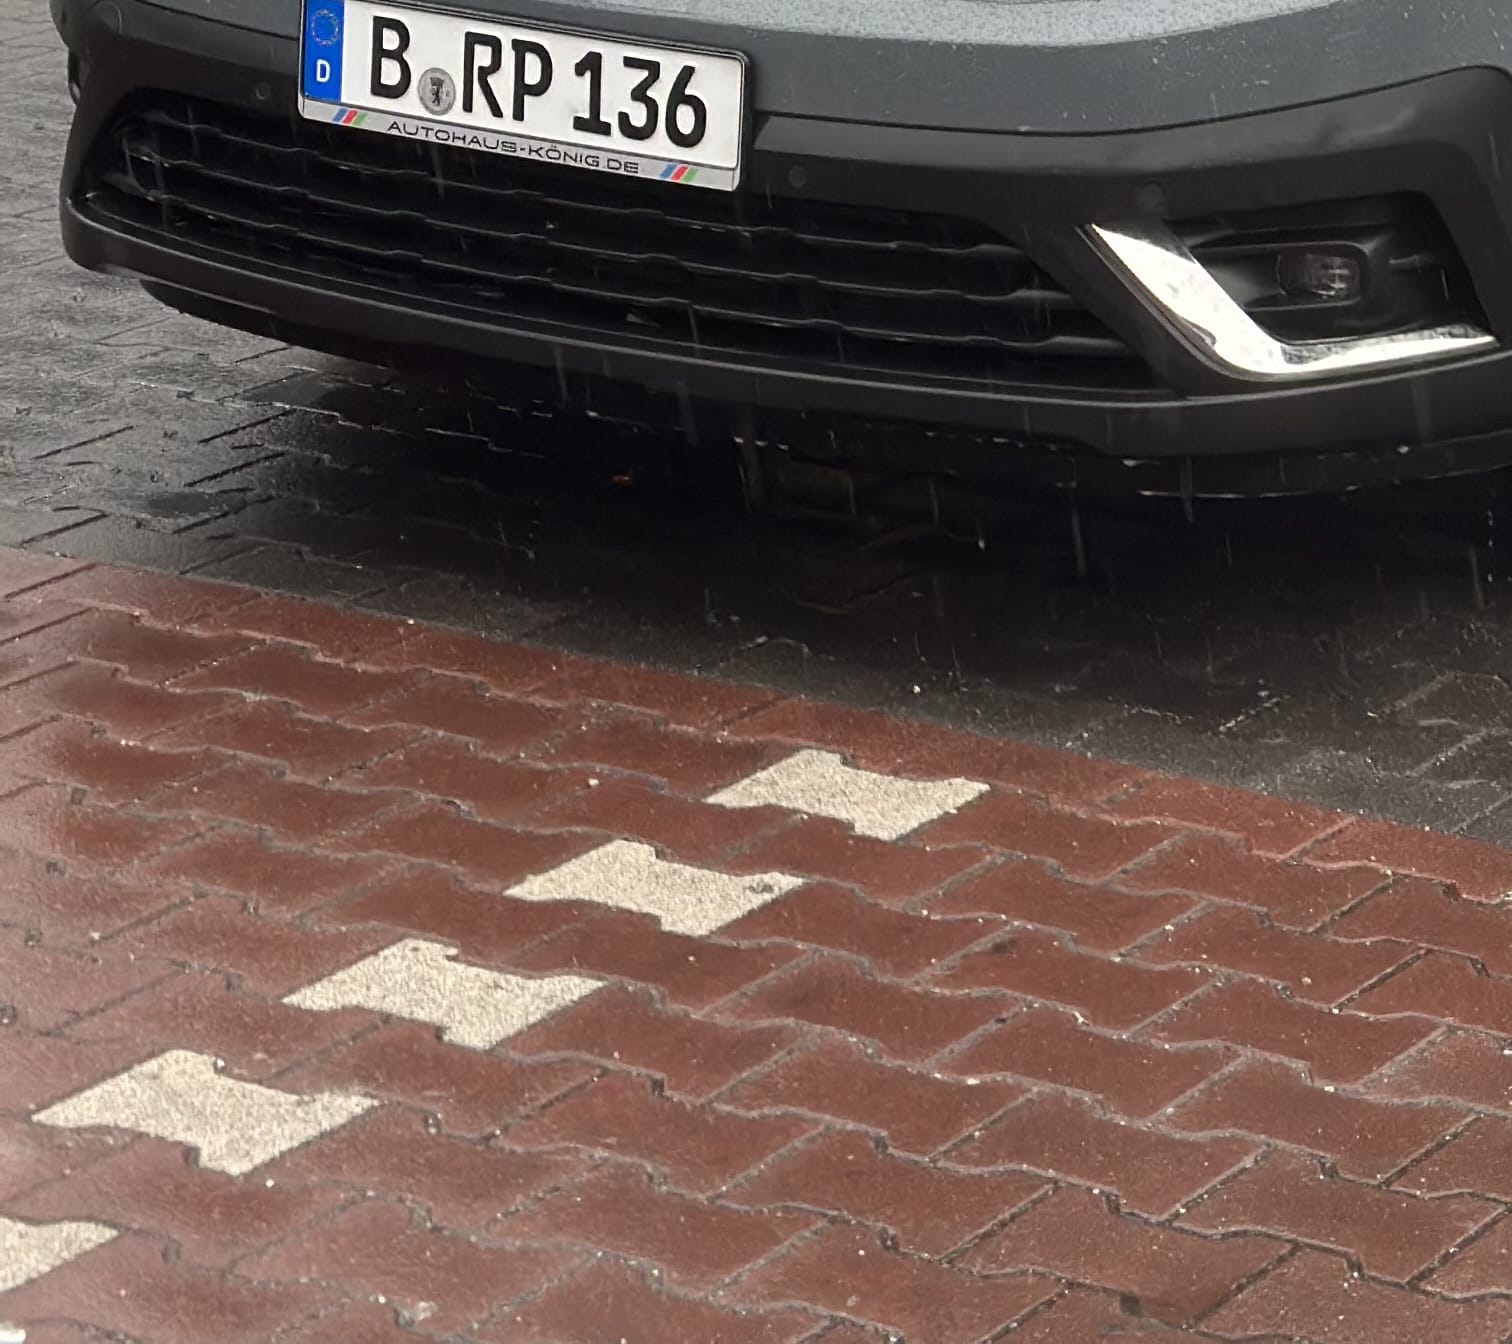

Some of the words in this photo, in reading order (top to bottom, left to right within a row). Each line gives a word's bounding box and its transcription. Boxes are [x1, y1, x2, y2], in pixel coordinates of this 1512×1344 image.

[315, 58, 331, 83] D
[370, 15, 411, 100] B
[462, 31, 553, 122] RP
[573, 50, 708, 149] 136
